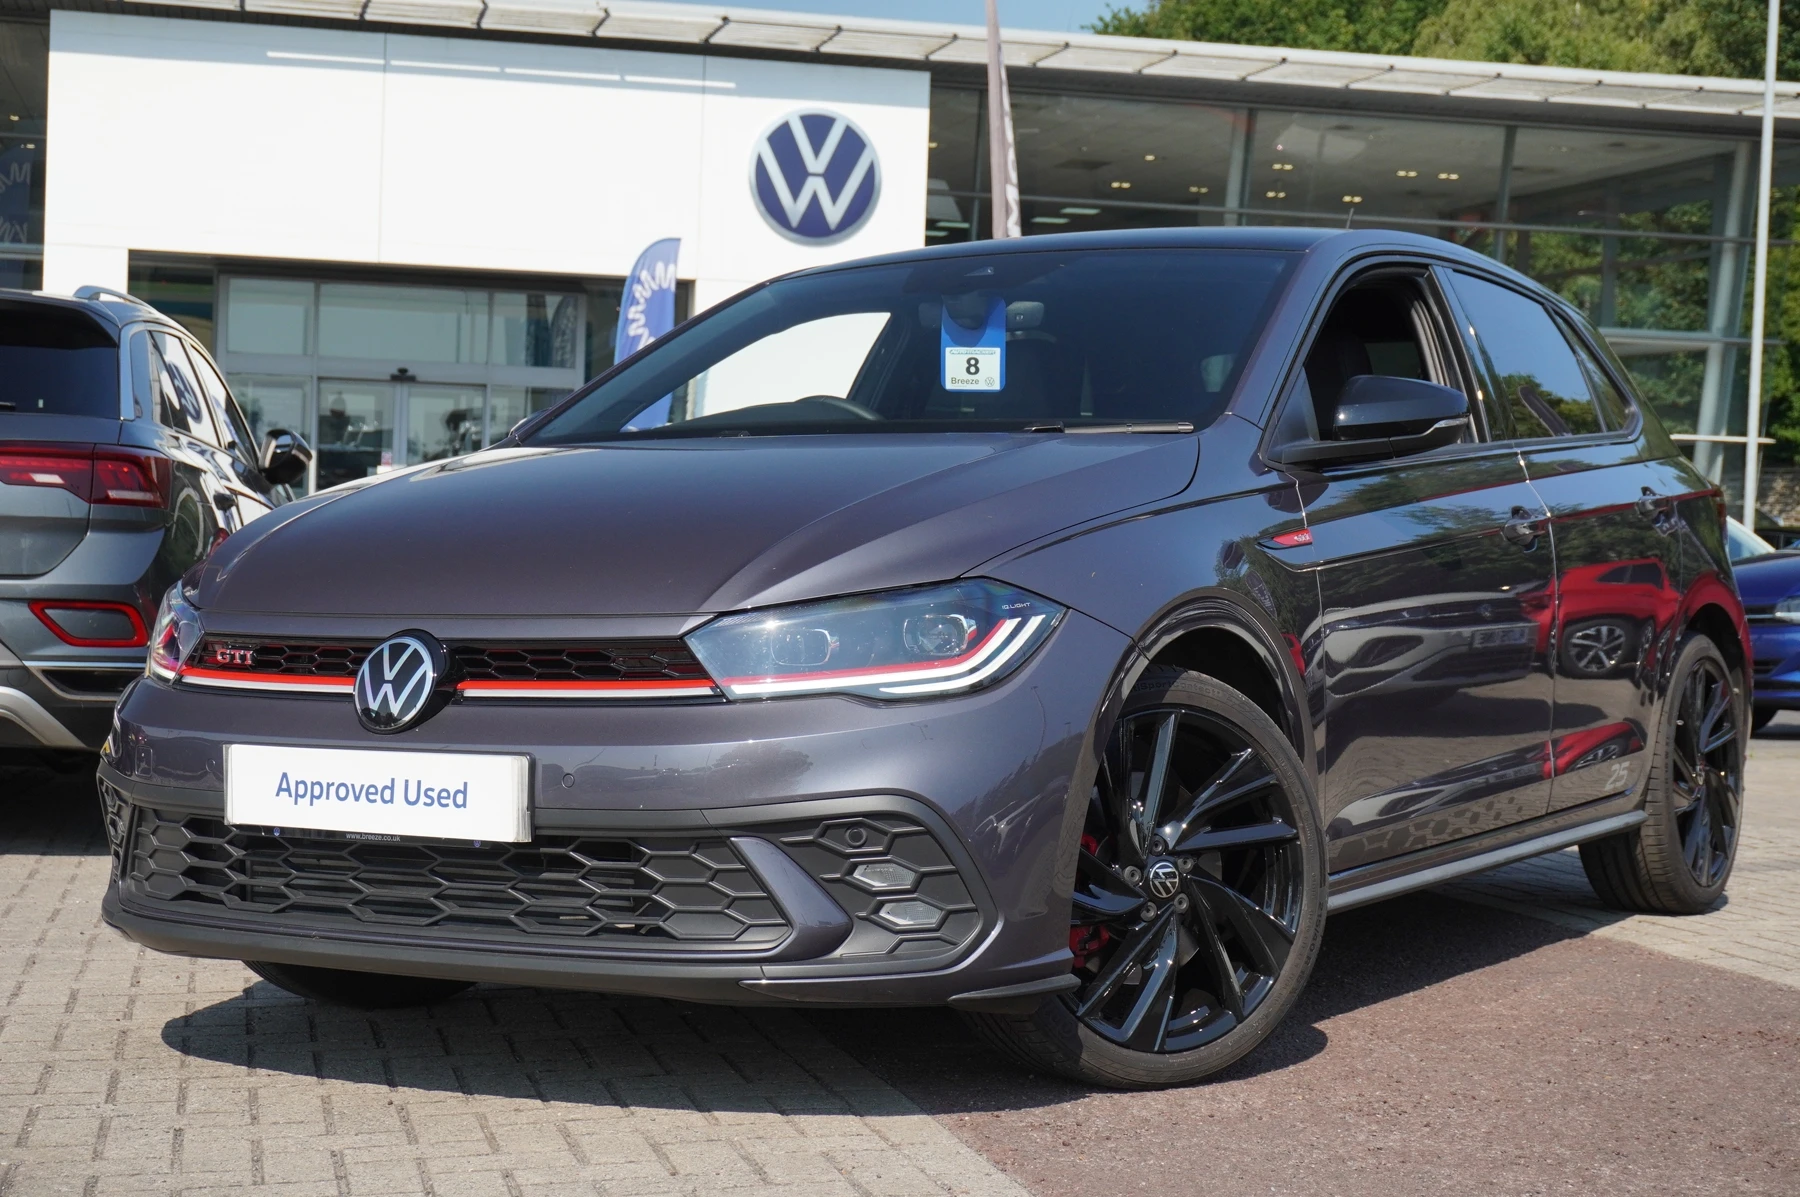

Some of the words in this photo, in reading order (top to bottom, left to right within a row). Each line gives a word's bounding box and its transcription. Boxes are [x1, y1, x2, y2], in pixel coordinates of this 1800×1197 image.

[750, 109, 881, 239] VW
[965, 356, 980, 375] 8
[950, 377, 979, 385] Breeze
[1001, 602, 1031, 610] IQ.LIGHT
[216, 648, 254, 665] GTI
[357, 638, 432, 724] VW
[1605, 761, 1631, 791] 25
[275, 771, 396, 807] Approved
[403, 779, 468, 809] Used
[345, 832, 401, 842] www.breeze.co.uk
